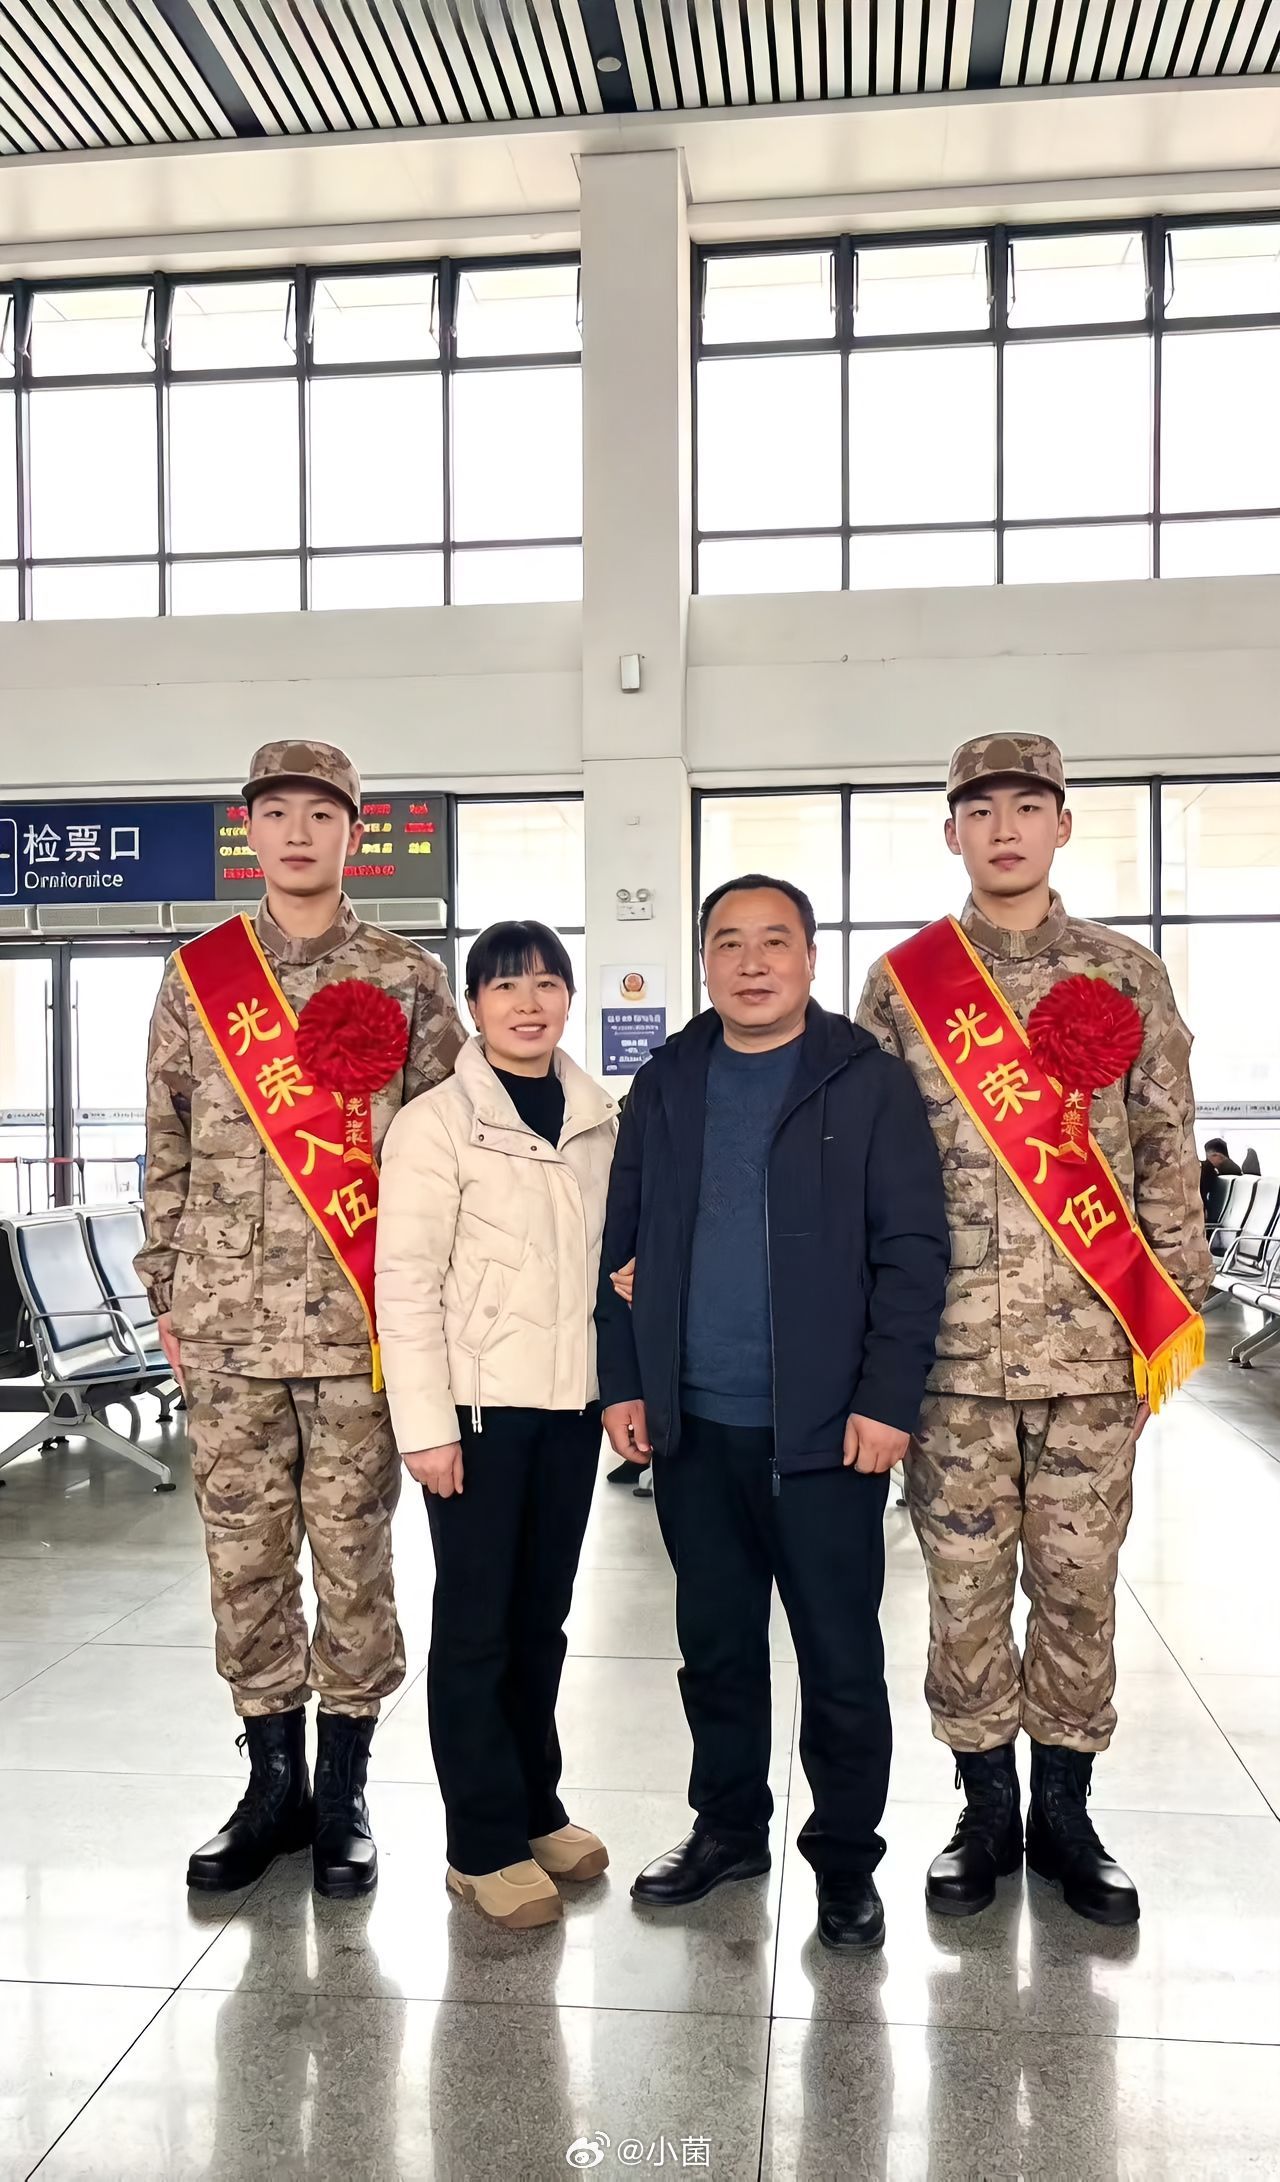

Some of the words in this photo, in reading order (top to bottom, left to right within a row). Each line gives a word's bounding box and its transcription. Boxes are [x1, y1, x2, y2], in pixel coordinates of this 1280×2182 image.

[23, 823, 140, 865] 检票口
[227, 997, 378, 1238] 光荣入伍
[945, 1002, 1117, 1248] 光荣入伍
